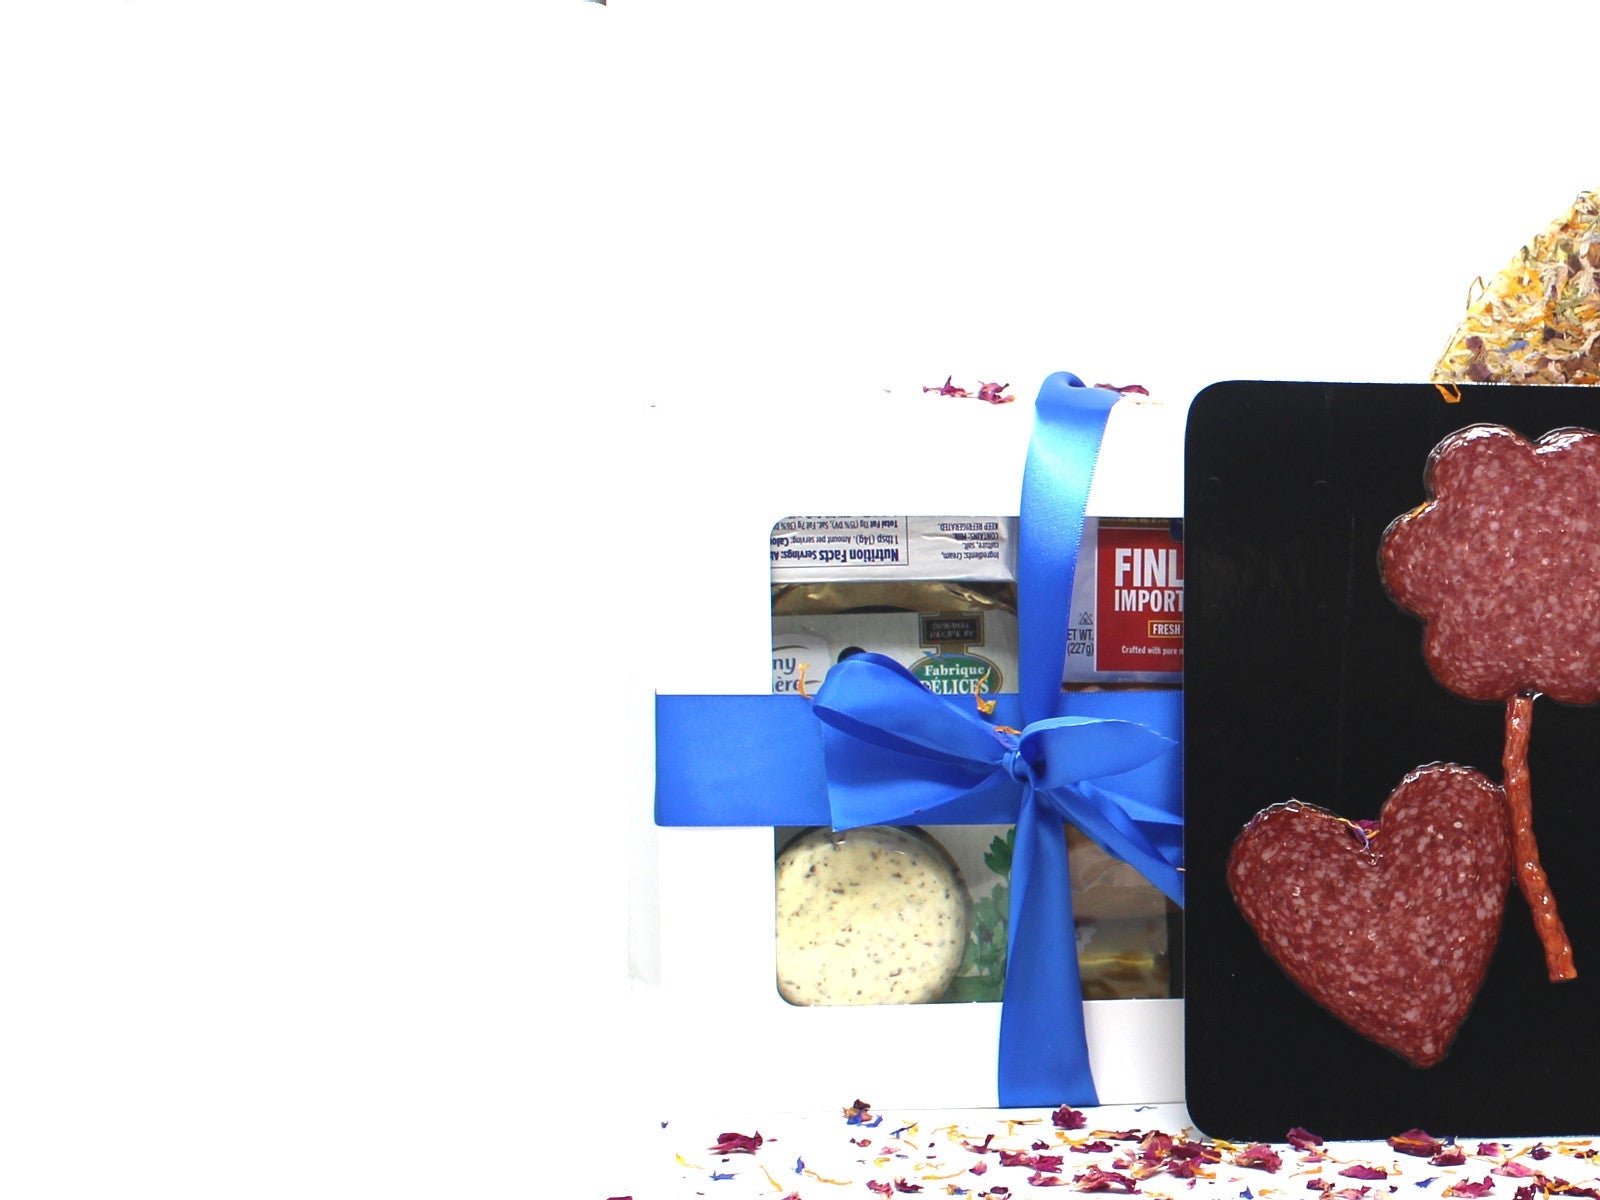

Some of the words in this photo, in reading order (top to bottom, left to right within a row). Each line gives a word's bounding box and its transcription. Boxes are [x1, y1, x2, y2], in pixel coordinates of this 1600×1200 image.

[806, 521, 816, 530] Fat
[870, 520, 880, 528] Fat
[882, 520, 898, 528] Total
[877, 535, 894, 544] tbsp
[781, 549, 817, 560] Servings:
[819, 550, 847, 562] Facts
[849, 549, 899, 562] Nutrition
[964, 551, 999, 560] Ingredients:
[1079, 629, 1094, 640] WT.
[1152, 624, 1181, 635] FRESH
[1067, 643, 1094, 656] (227g)
[1121, 645, 1146, 654] Crafted
[1147, 646, 1162, 654] with
[1163, 647, 1177, 656] pure
[924, 664, 985, 678] Fabrique
